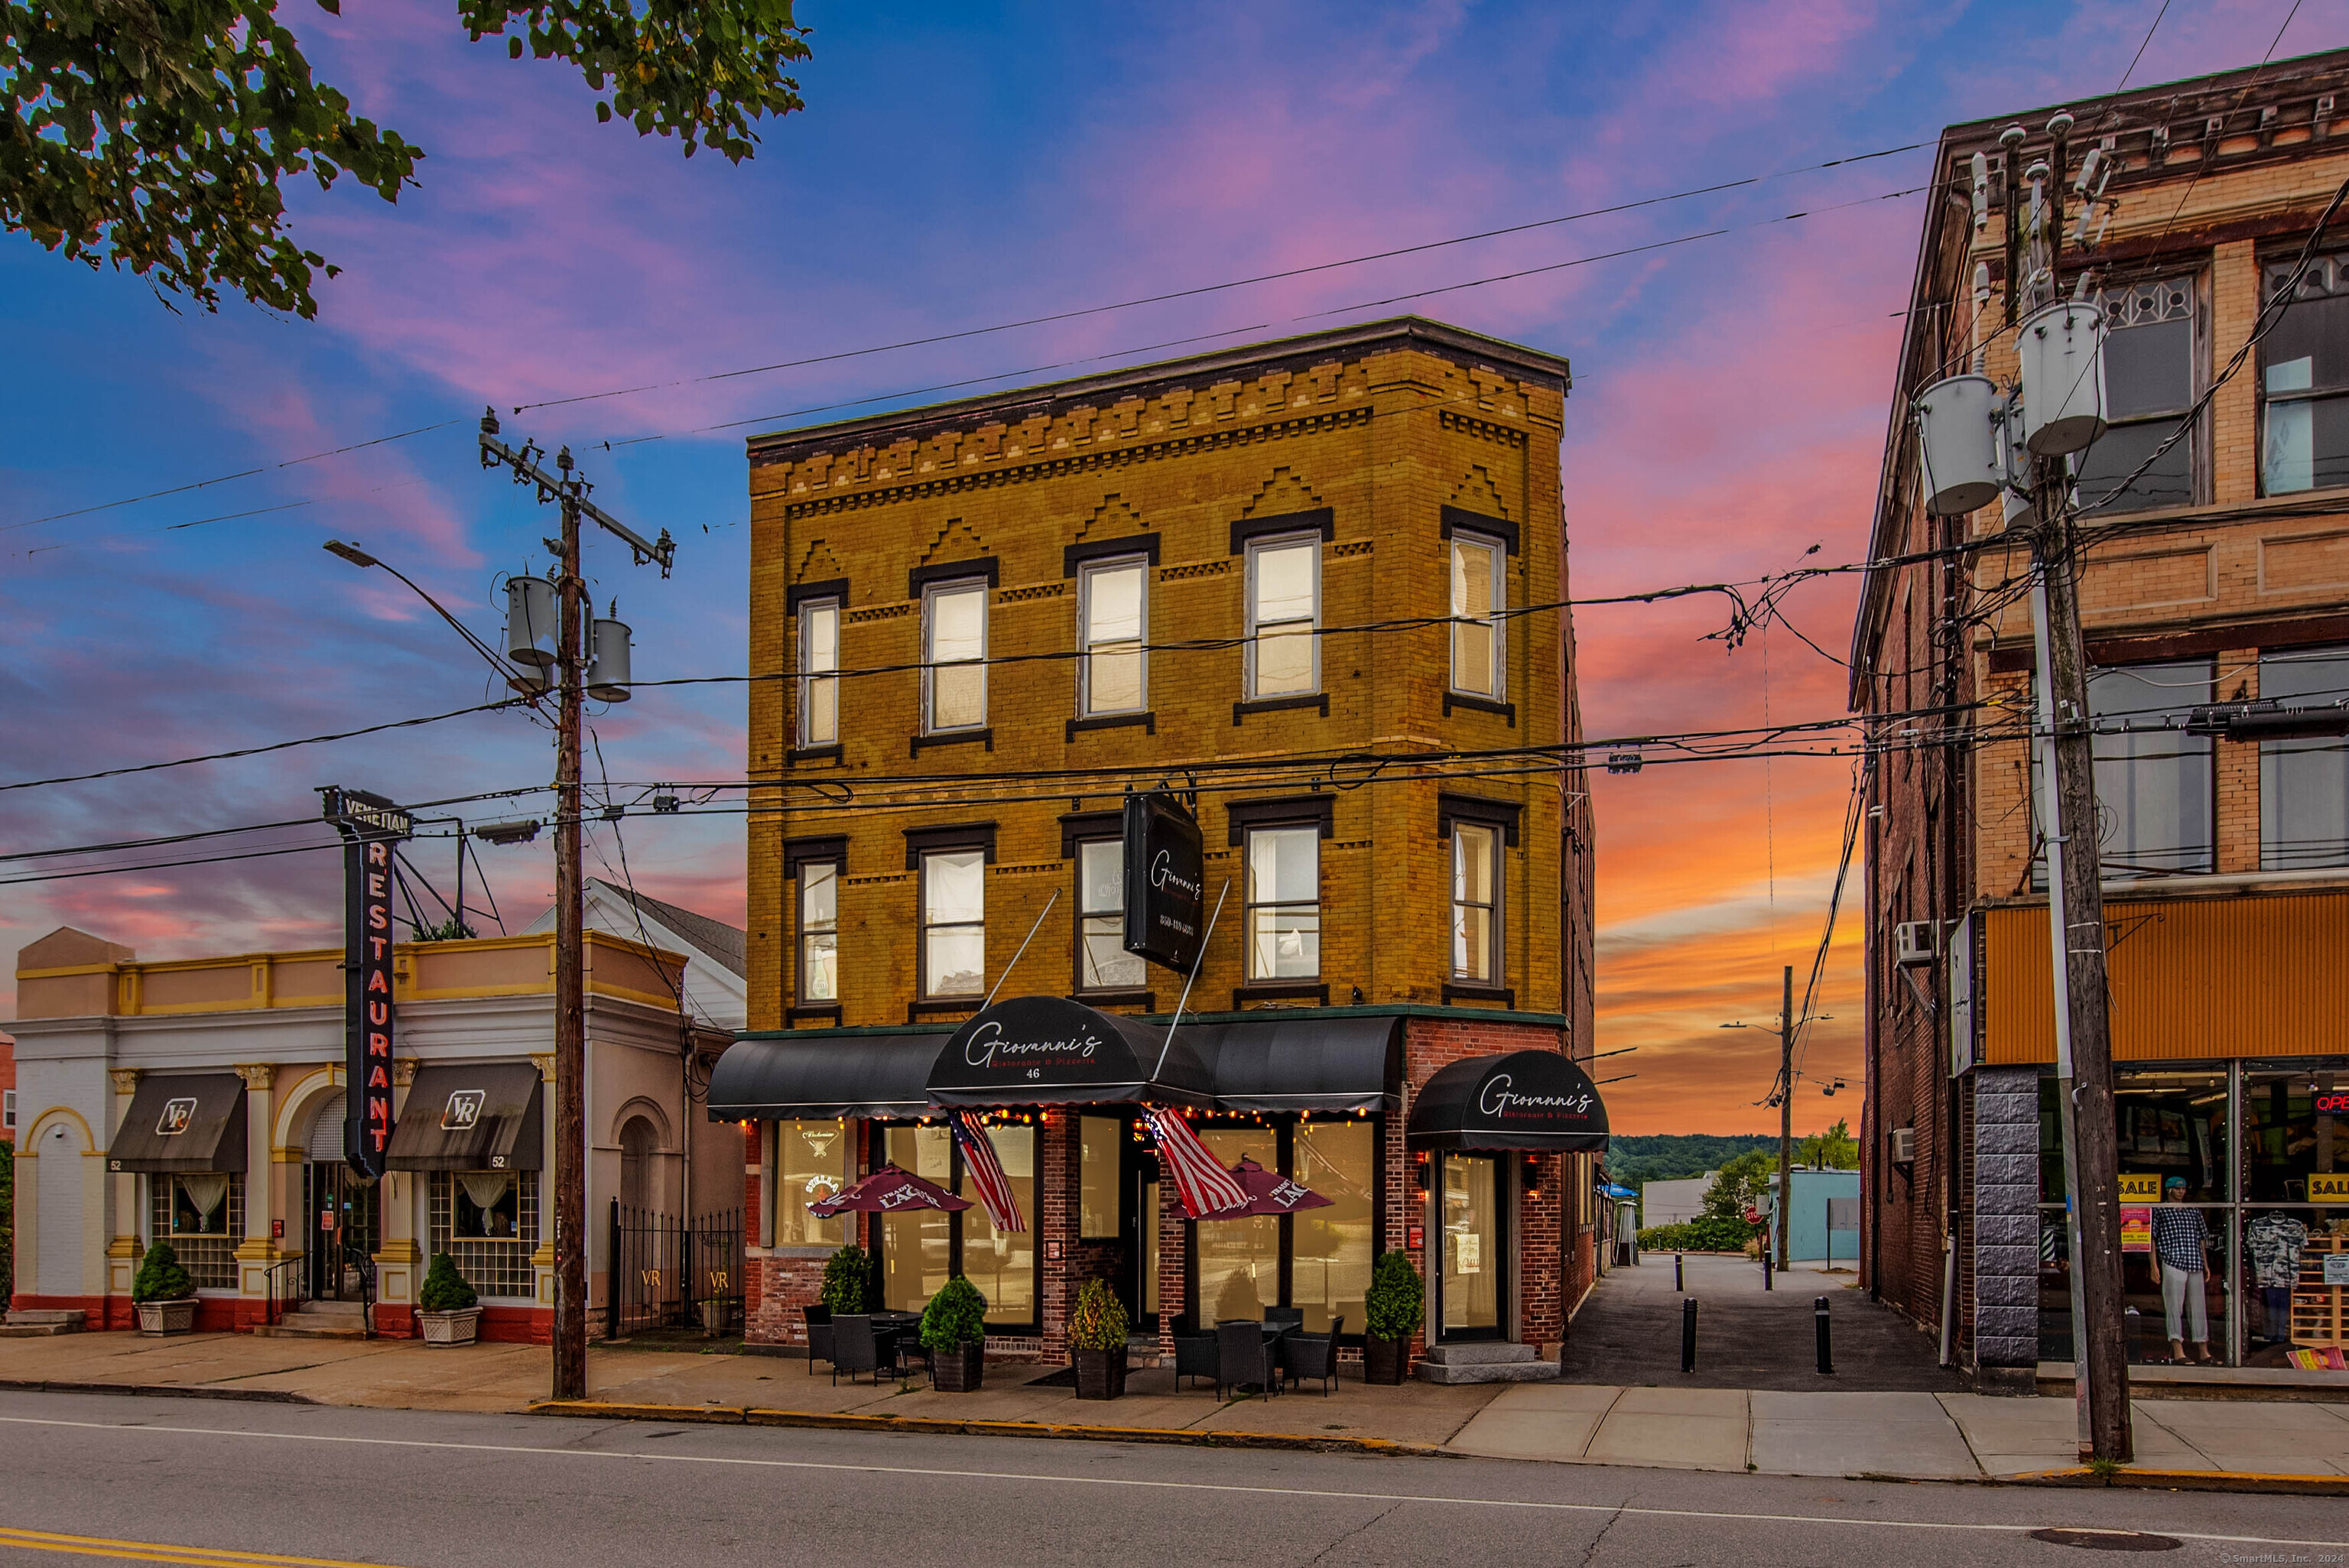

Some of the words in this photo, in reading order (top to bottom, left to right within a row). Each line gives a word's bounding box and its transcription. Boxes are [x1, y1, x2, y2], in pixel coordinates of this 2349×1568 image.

[346, 797, 409, 834] VENETIAN
[1151, 849, 1201, 900] Giovanni's
[368, 842, 388, 1152] RESTAURANT
[965, 1021, 1103, 1068] Giovanni's
[1026, 1069, 1040, 1079] 46
[1480, 1073, 1594, 1118] Giovanni's
[169, 1105, 187, 1128] VR
[454, 1097, 475, 1122] VR
[110, 1161, 121, 1170] 52
[492, 1156, 505, 1167] 52
[805, 1174, 839, 1193] STELLA
[2118, 1181, 2157, 1195] SALE
[2312, 1180, 2349, 1195] SAL
[642, 1270, 661, 1286] VR
[710, 1271, 728, 1288] VR
